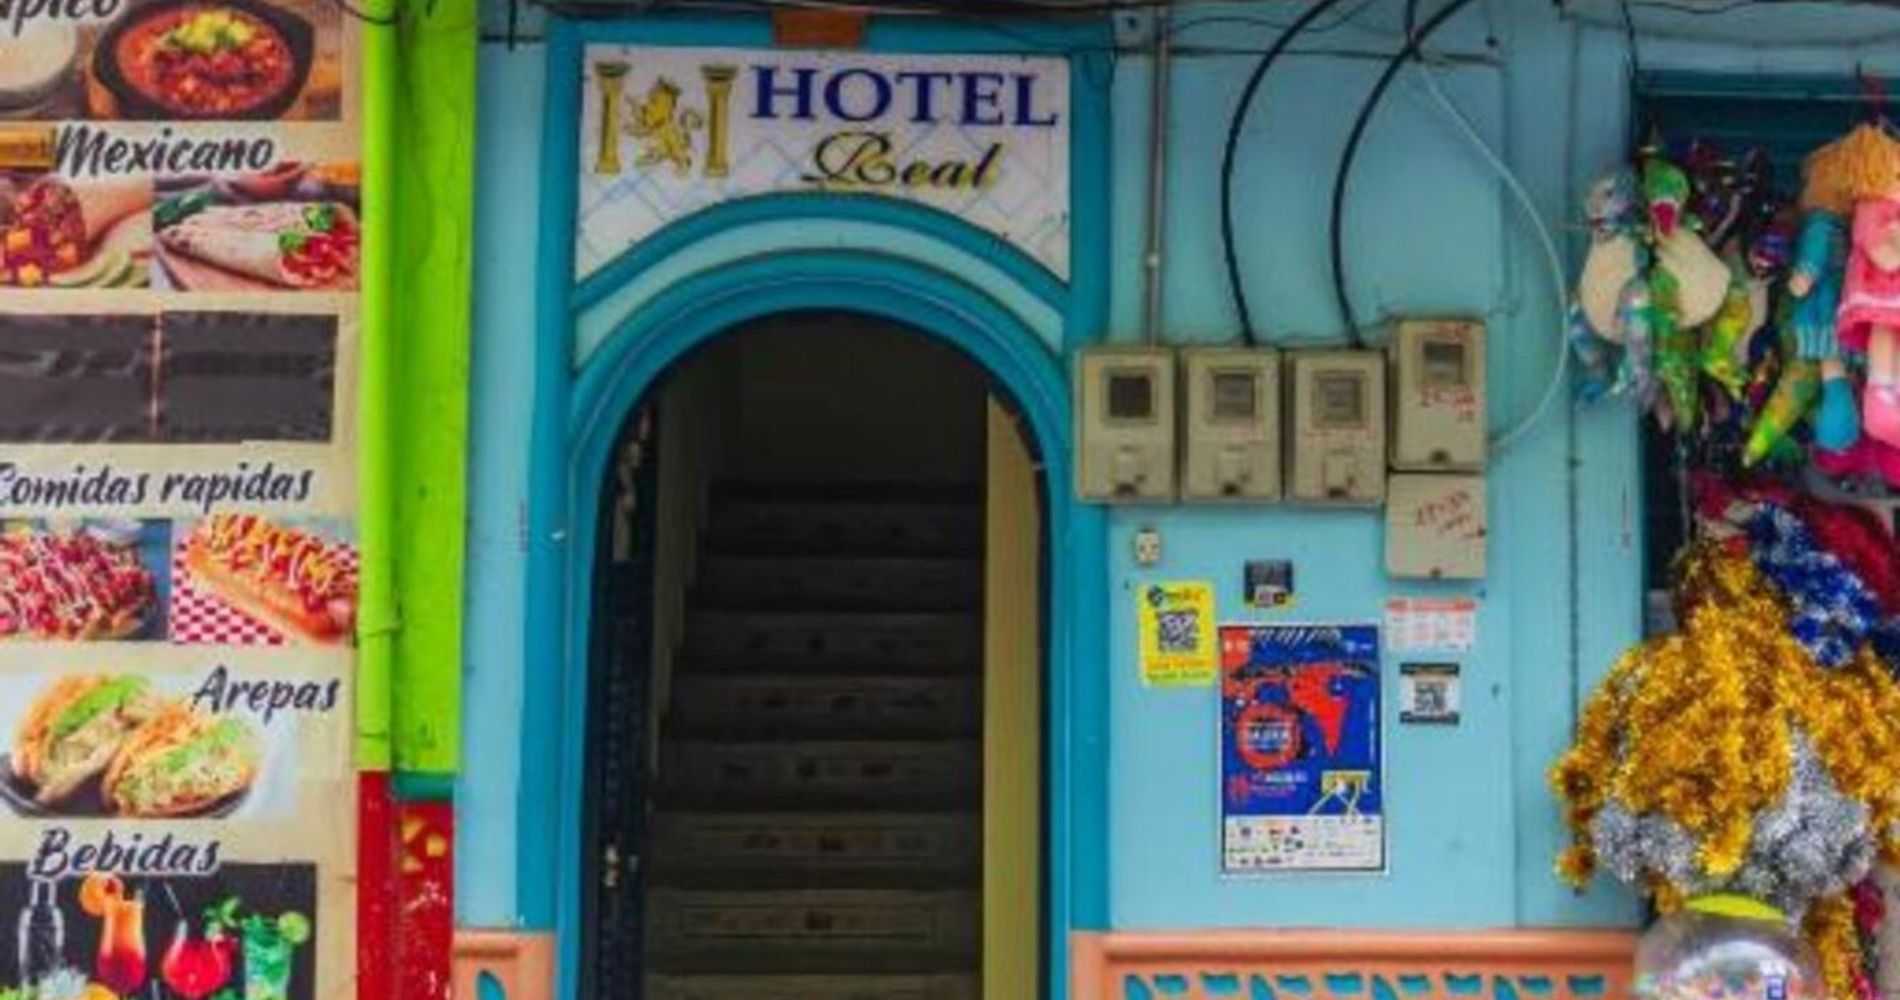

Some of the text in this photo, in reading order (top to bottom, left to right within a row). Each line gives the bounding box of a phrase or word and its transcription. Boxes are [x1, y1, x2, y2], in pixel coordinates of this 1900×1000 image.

[749, 65, 1059, 127] HOTEL
[56, 124, 274, 176] Mexicano
[802, 129, 1002, 190] Real
[160, 463, 312, 511] rapidas
[193, 665, 340, 722] Arepas
[32, 829, 219, 878] Bebidas
